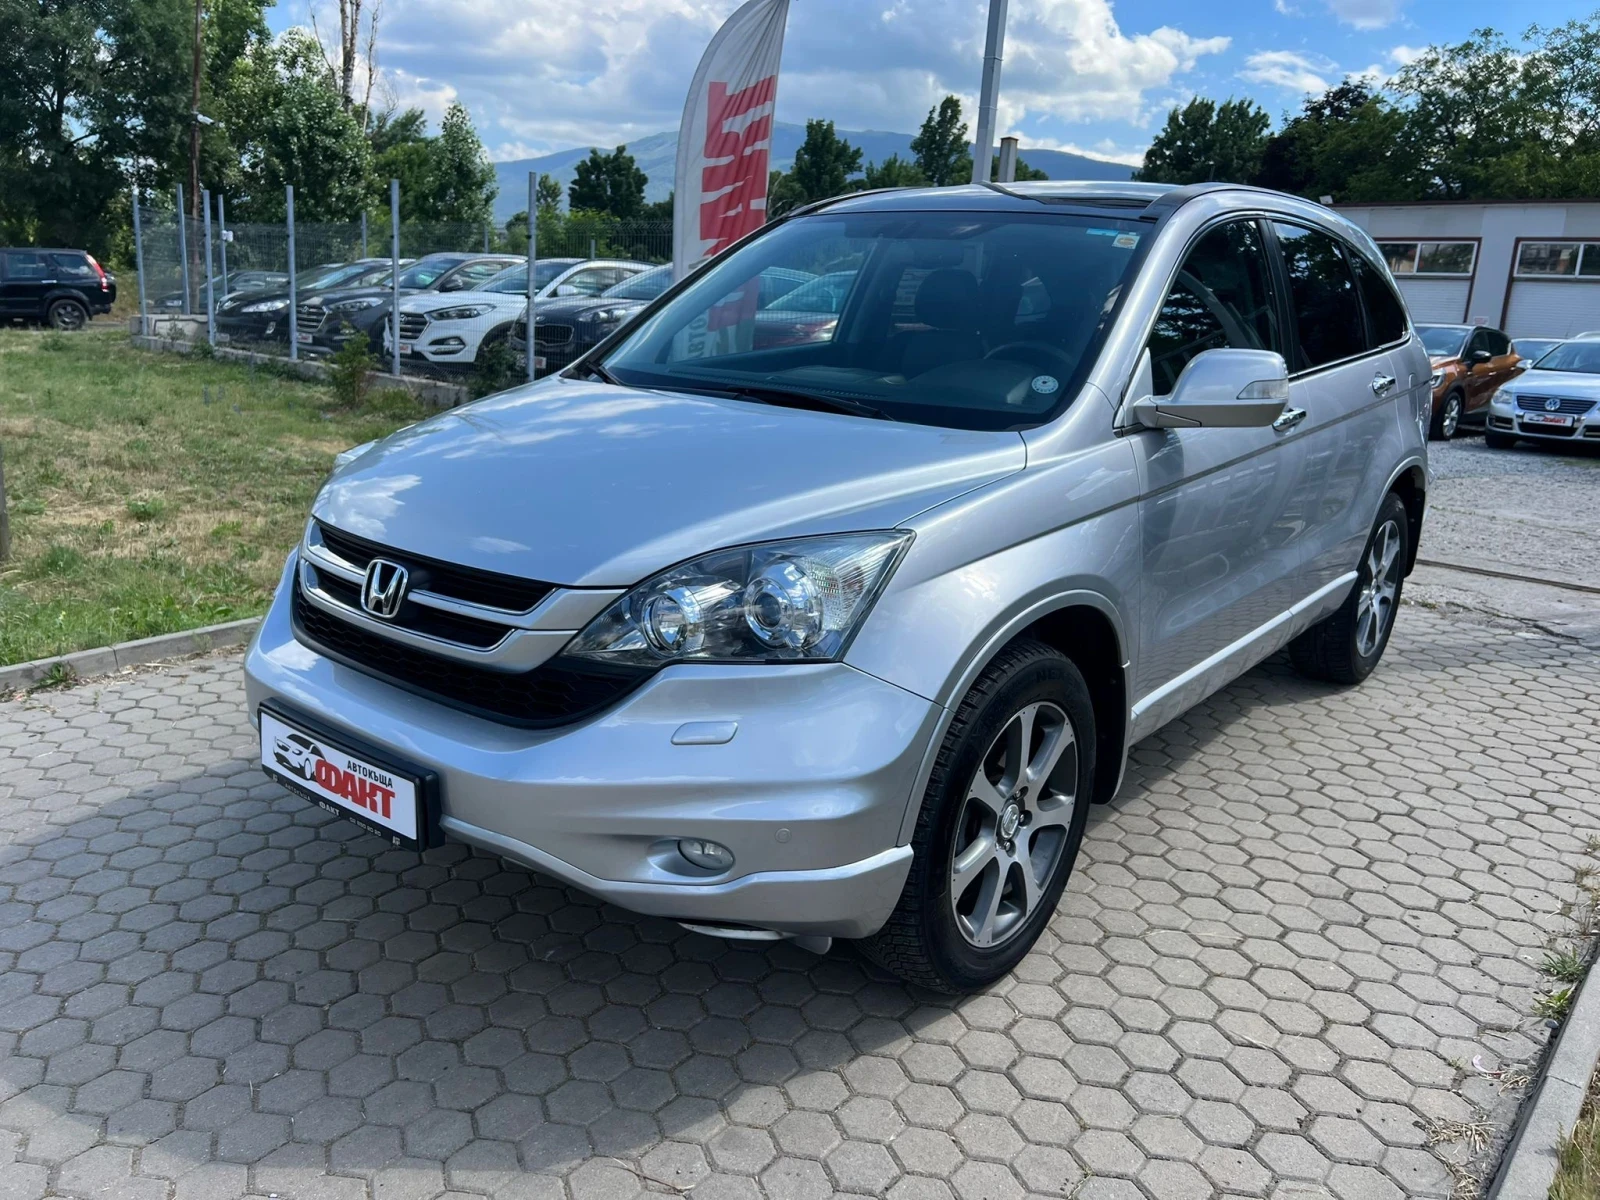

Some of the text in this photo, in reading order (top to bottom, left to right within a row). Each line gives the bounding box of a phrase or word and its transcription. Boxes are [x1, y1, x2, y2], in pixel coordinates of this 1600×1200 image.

[347, 760, 393, 789] АВТОКЪЩА
[315, 759, 396, 820] ФАКТ
[318, 801, 340, 816] ФАКТ
